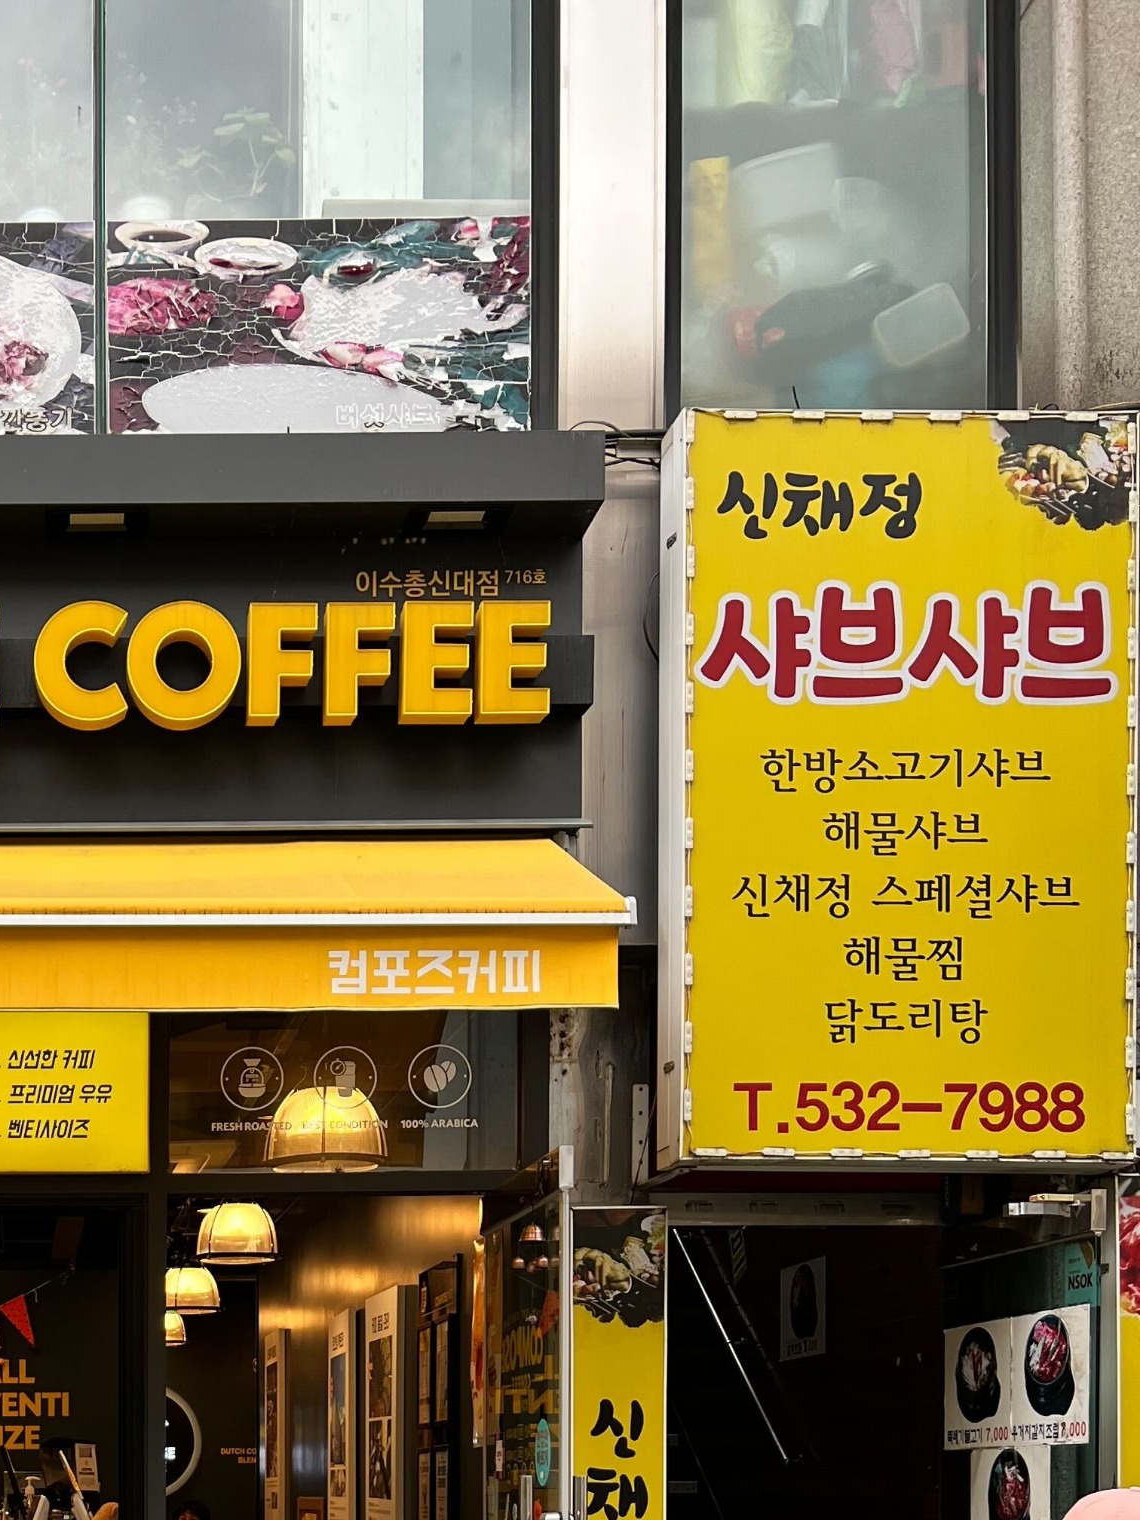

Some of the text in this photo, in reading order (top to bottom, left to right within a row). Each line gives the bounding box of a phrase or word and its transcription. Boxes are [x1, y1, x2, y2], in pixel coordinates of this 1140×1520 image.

[716, 470, 923, 540] 신채정
[354, 567, 547, 598] 이수총신대점 716호
[33, 600, 552, 730] COFFEE
[697, 583, 1116, 703] 샤브샤브
[759, 748, 1052, 794] 한방소고기샤브
[822, 810, 989, 857] 해물샤브
[731, 873, 1081, 919] 신채정 스페셜샤브
[328, 949, 542, 996] 컴포즈커피
[843, 935, 964, 982] 해물찜
[824, 998, 989, 1045] 닭도리탕
[7, 1049, 96, 1069] 신선한 커피
[7, 1084, 113, 1104] 프리미엄 우유
[732, 1081, 1086, 1134] T.532-7988
[7, 1119, 91, 1138] 벤티사이즈
[211, 1121, 244, 1132] FRESH
[244, 1120, 292, 1132] ROASTED
[329, 1118, 388, 1130] CONDITION
[400, 1119, 430, 1129] 100%
[430, 1118, 479, 1129] ARABICA
[1067, 1272, 1093, 1290] NSOK
[220, 1447, 245, 1455] DUTCH
[985, 1426, 1009, 1444] 7,000
